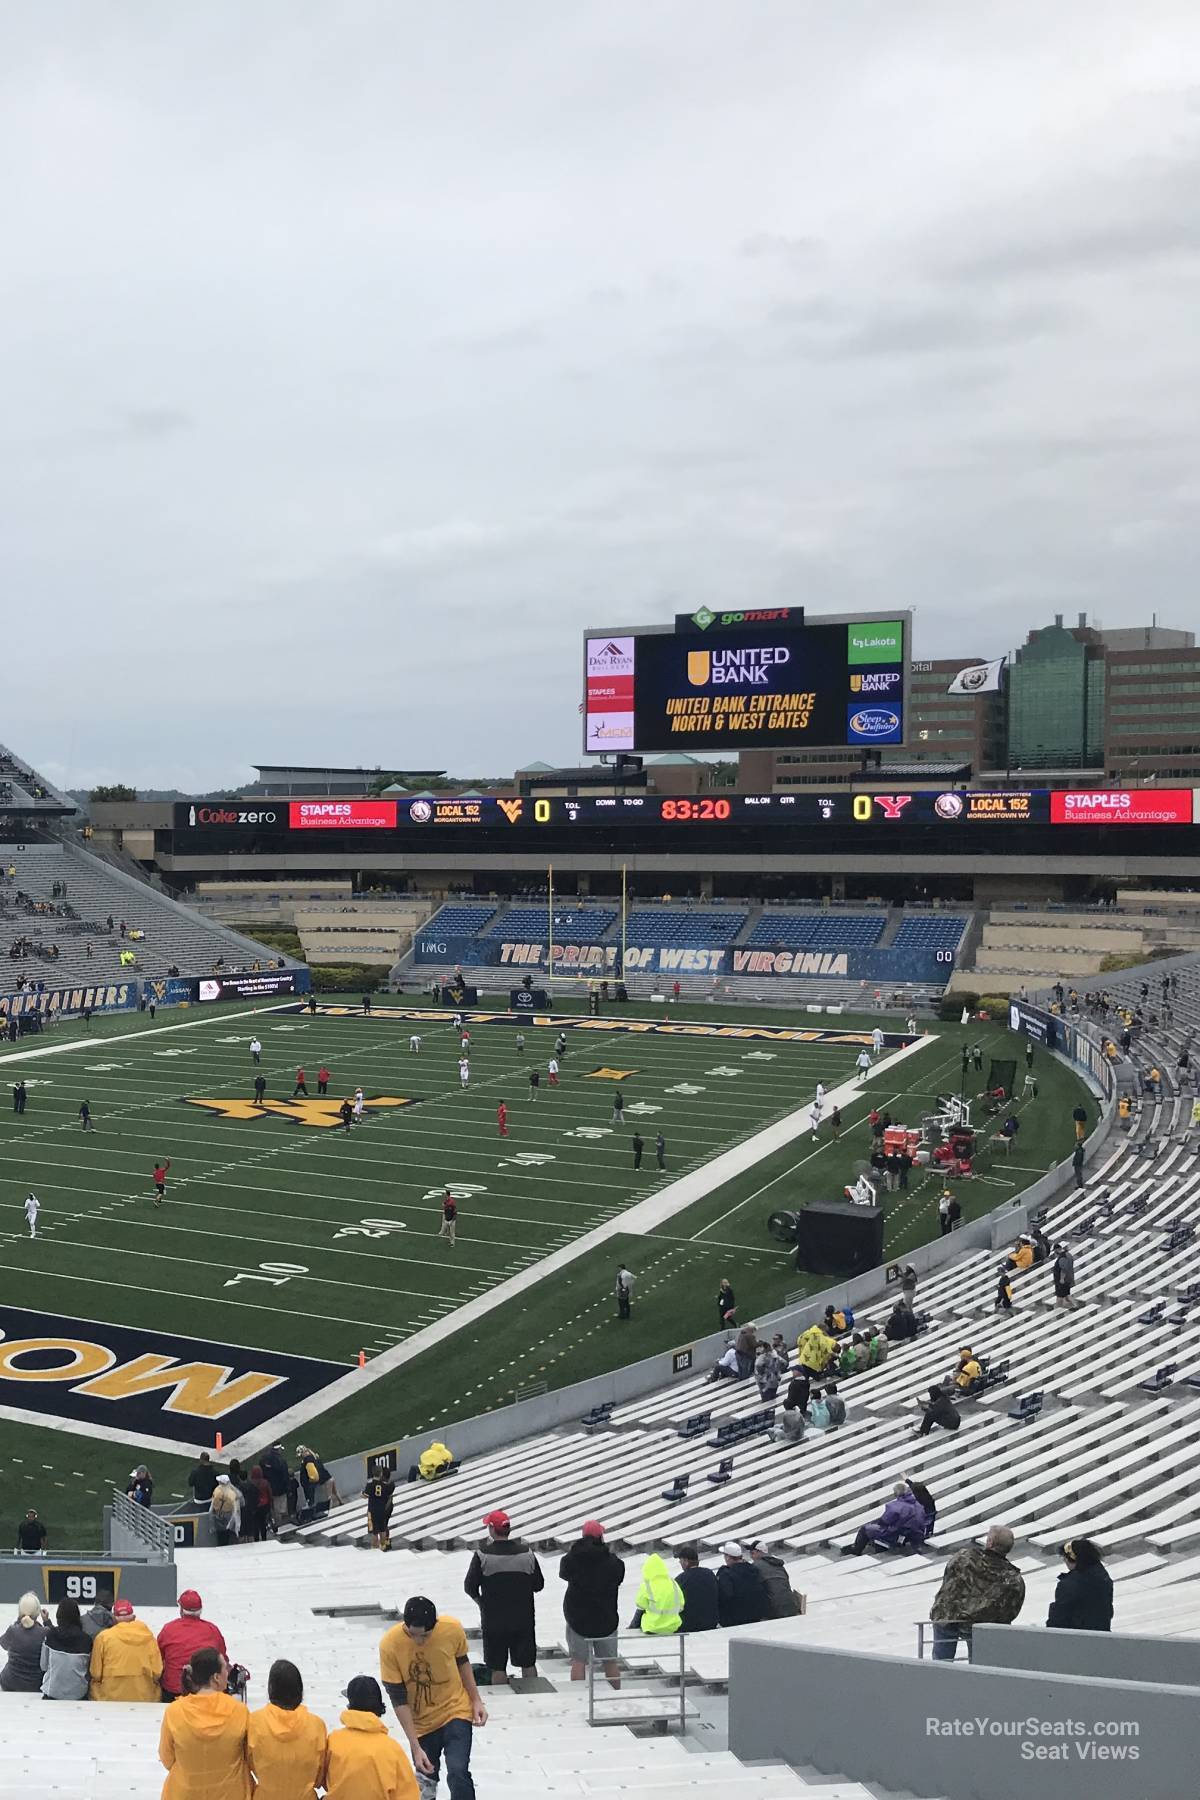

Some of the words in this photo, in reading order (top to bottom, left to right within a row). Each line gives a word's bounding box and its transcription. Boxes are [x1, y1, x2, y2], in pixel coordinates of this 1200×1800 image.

[721, 607, 790, 625] gomart
[864, 637, 896, 647] Lakota
[712, 647, 790, 666] UNITED
[712, 665, 769, 684] BANK
[861, 673, 900, 683] UNITED
[588, 688, 616, 696] STAPLES
[861, 681, 890, 691] BANK
[666, 697, 710, 715] UNITED
[713, 695, 748, 713] BANK
[749, 692, 817, 712] ENTRANCE
[671, 715, 712, 732] NORTH
[715, 714, 725, 730] &
[729, 712, 767, 730] WEST
[768, 711, 809, 729] GATES
[858, 712, 883, 725] Sleep
[853, 795, 872, 820] 0
[874, 796, 912, 817] Y
[971, 799, 1007, 811] LOCAL
[1008, 798, 1028, 810] 152
[1065, 794, 1131, 808] STAPLES
[199, 808, 237, 823] Coke
[237, 809, 276, 823] zero
[300, 804, 351, 816] STAPLES
[437, 805, 464, 816] LOCAL
[465, 804, 479, 815] 152
[534, 799, 550, 822] 0
[569, 810, 577, 820] 3
[661, 800, 731, 820] 83:20
[822, 808, 831, 818] 3
[1065, 810, 1113, 820] Business
[1114, 809, 1177, 821] Advantage
[300, 817, 337, 825] Business
[338, 816, 386, 826] Advantage
[421, 942, 448, 954] IMG
[500, 943, 543, 964] THE
[545, 945, 618, 968] PRIDE
[624, 947, 653, 968] OF
[659, 948, 725, 970] WEST
[733, 951, 849, 975] VIRGINIA
[301, 1003, 518, 1023] WEST
[533, 1016, 876, 1046] VIRGINIA
[340, 1218, 407, 1239] 20
[233, 1262, 309, 1286] 10
[374, 1484, 382, 1497] 8
[66, 1576, 97, 1599] 99
